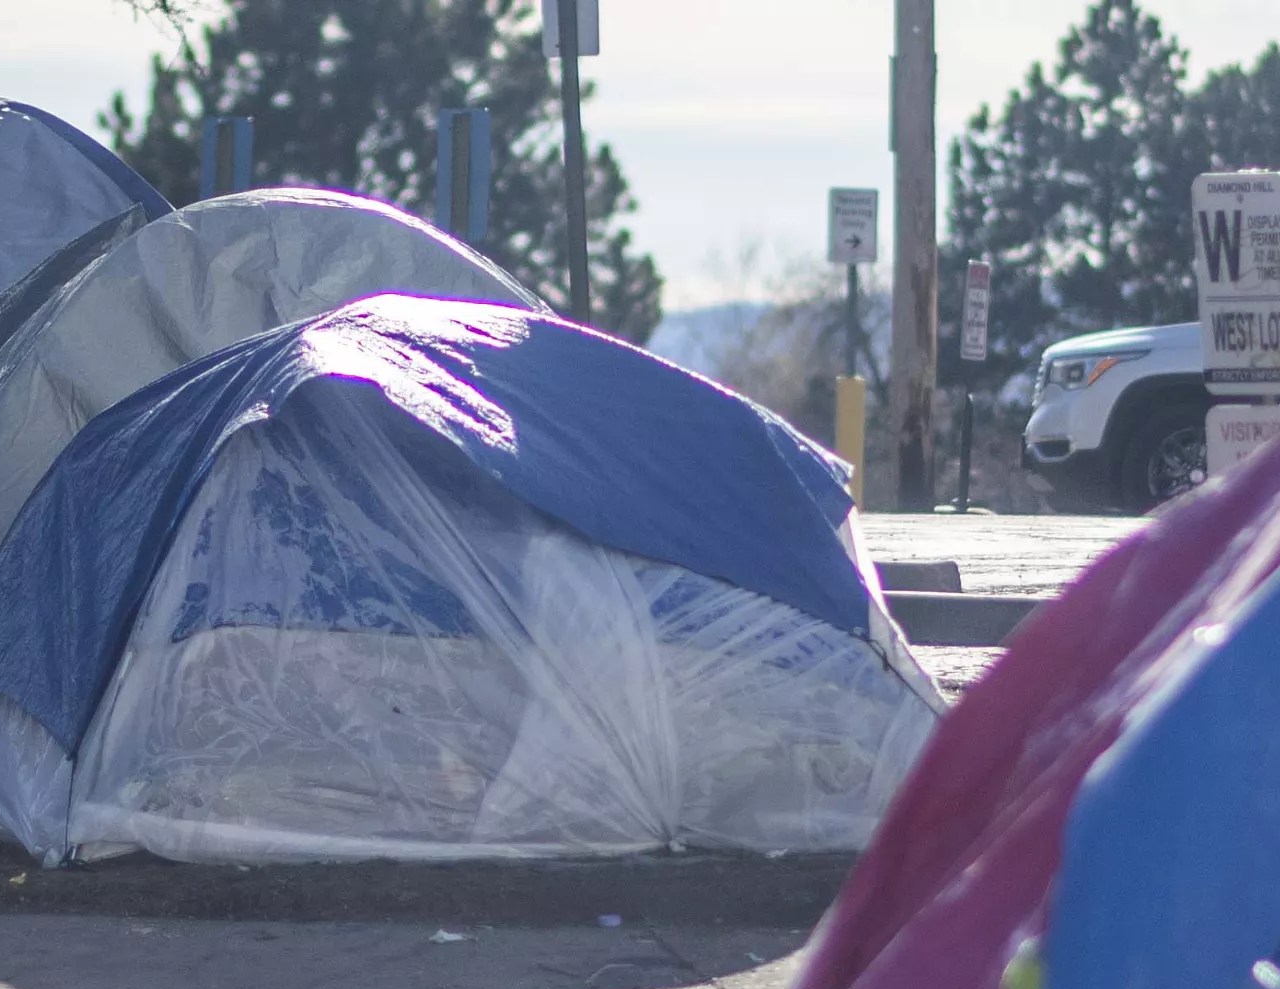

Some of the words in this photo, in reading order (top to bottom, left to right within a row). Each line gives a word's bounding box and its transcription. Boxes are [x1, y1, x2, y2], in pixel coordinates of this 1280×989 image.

[1206, 183, 1251, 193] DIAMOND
[1253, 182, 1274, 193] HILL
[1198, 210, 1242, 283] W
[1253, 249, 1265, 263] AT
[1211, 312, 1254, 351] WEST
